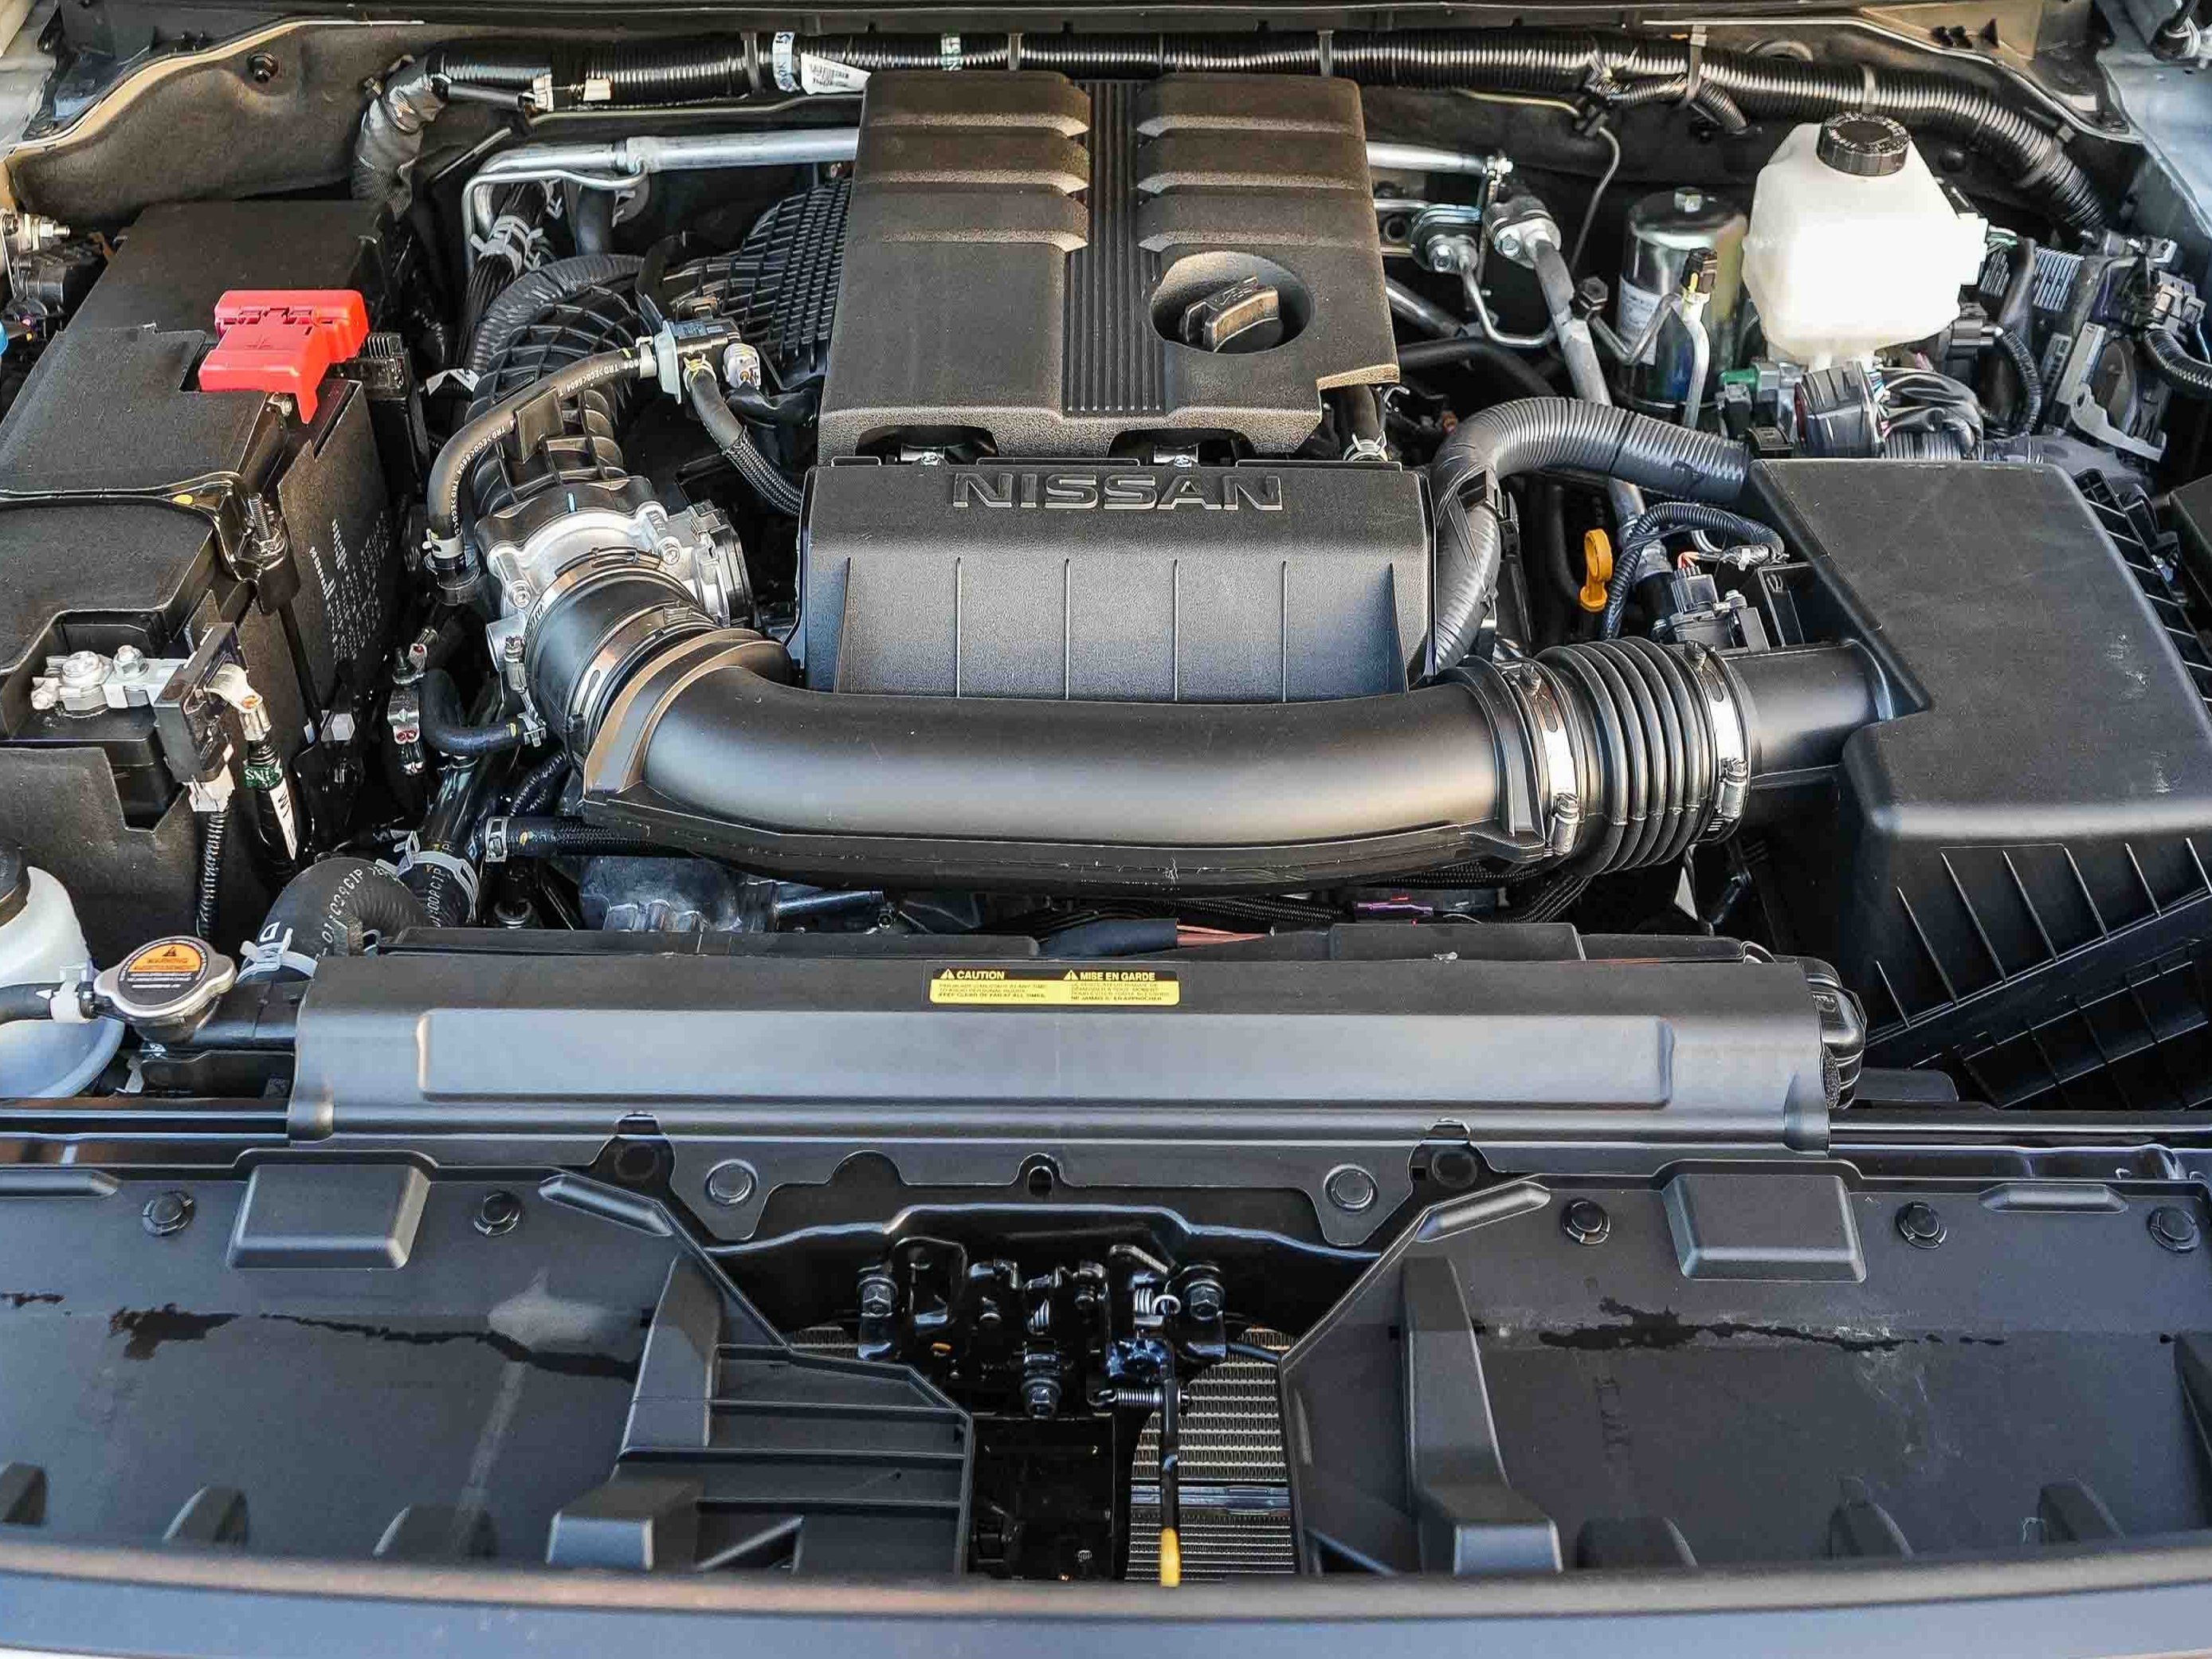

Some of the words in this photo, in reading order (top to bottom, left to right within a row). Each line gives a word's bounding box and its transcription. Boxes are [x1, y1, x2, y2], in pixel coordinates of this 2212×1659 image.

[952, 472, 1284, 511] NISSAN
[956, 971, 1005, 980] CAUTION
[1080, 971, 1104, 981] MISE
[1105, 971, 1120, 981] EN
[1121, 972, 1155, 981] GARDE
